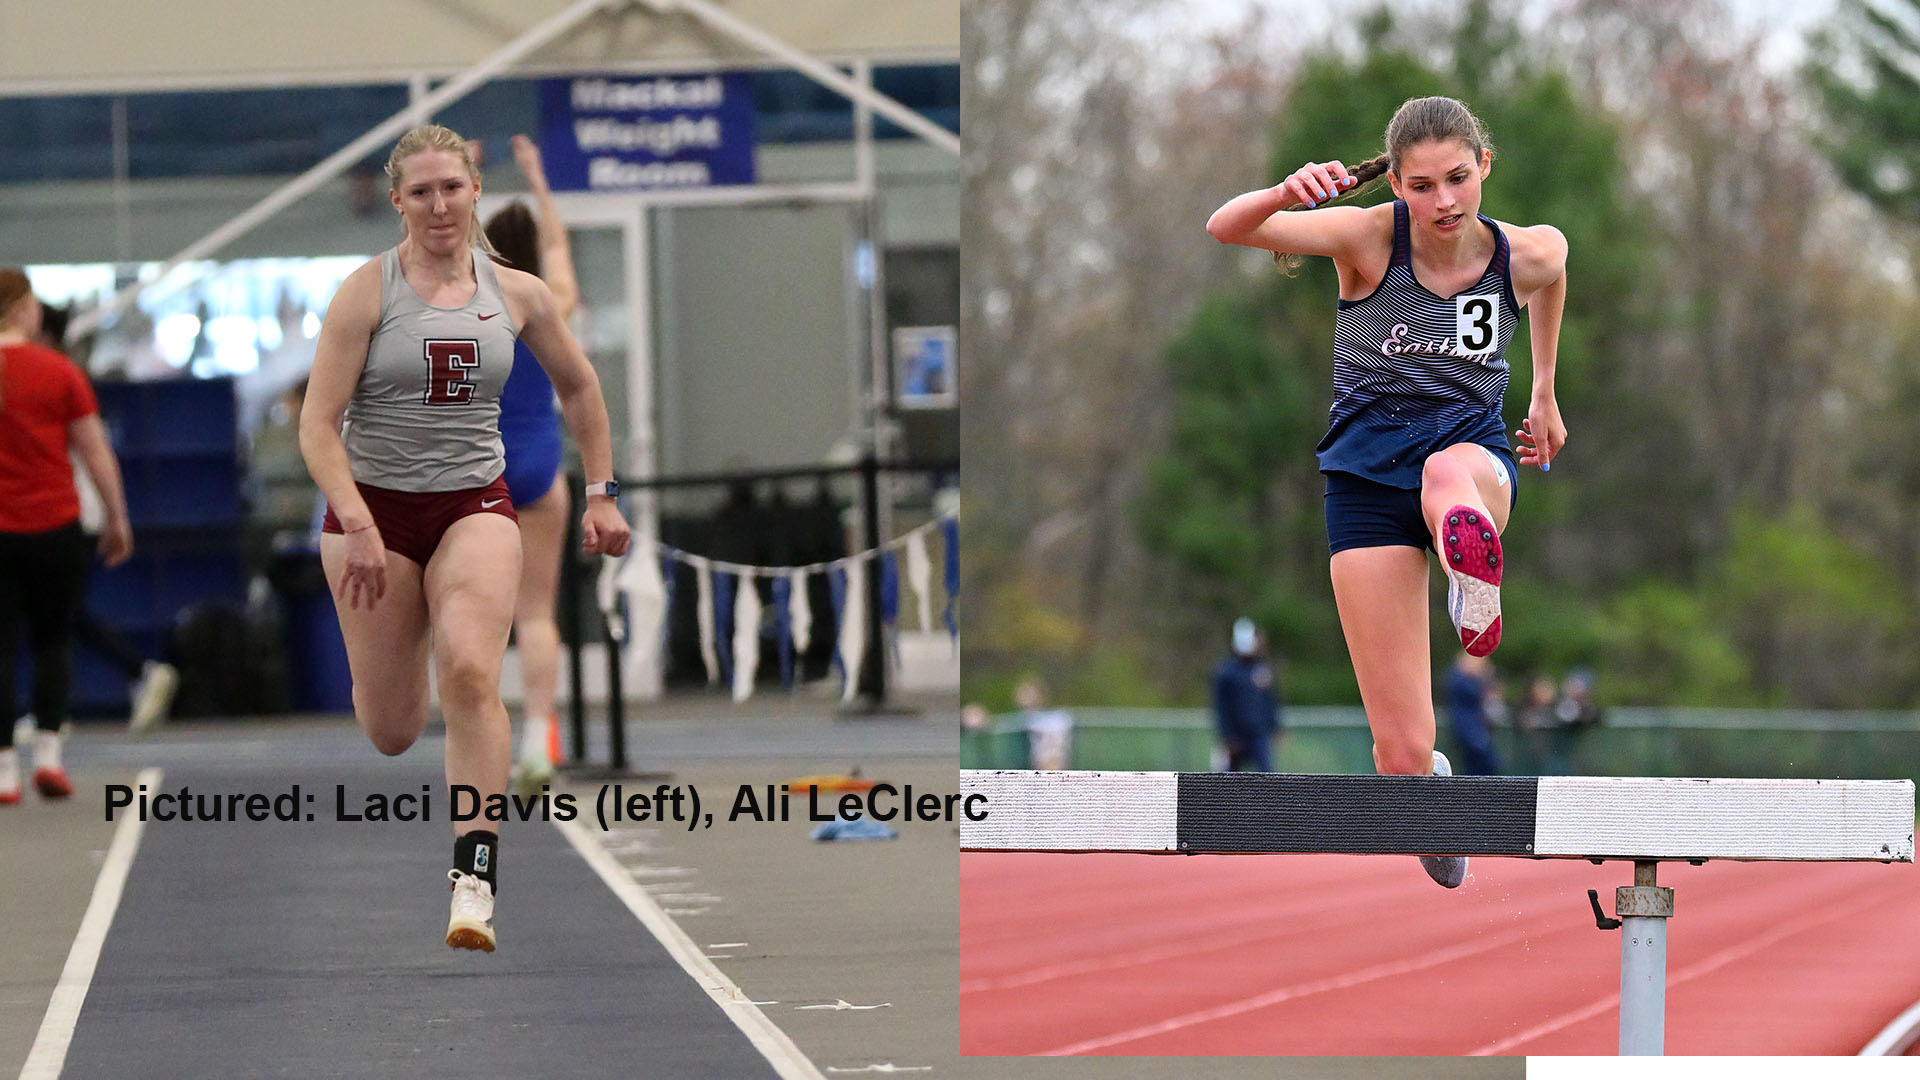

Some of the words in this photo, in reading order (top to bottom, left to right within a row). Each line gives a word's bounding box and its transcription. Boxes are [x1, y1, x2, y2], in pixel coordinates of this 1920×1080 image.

[1381, 322, 1489, 366] East
[1461, 298, 1493, 351] 3
[423, 338, 480, 406] E
